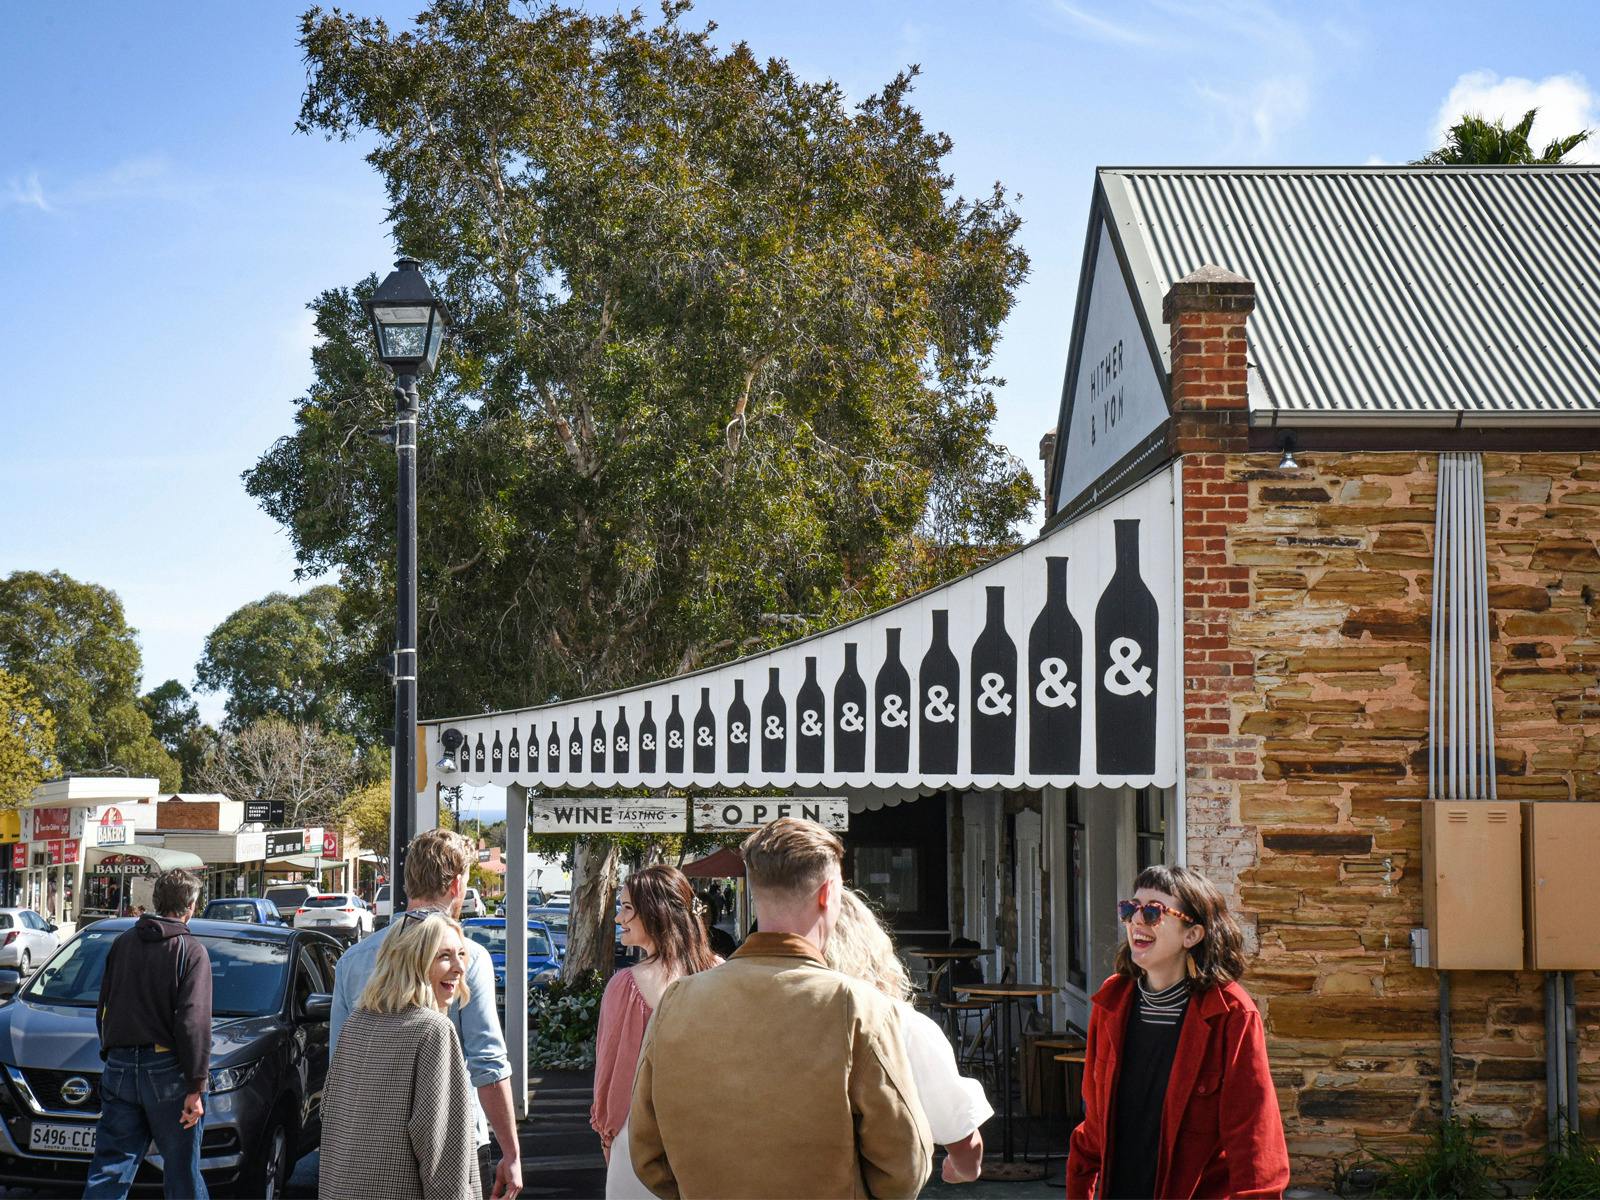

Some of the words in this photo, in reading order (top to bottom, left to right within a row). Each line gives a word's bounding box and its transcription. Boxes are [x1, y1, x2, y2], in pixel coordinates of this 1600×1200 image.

[1091, 339, 1123, 404] HITHER
[1091, 413, 1096, 447] &
[1104, 385, 1124, 434] YON
[461, 750, 470, 761] &
[476, 749, 485, 760] &
[492, 748, 502, 759] &
[509, 746, 519, 759] &
[528, 745, 539, 758] &
[548, 743, 560, 757] &
[570, 741, 582, 756] &
[592, 738, 606, 754] &
[615, 735, 629, 752] &
[643, 734, 655, 750] &
[669, 730, 683, 748] &
[697, 727, 713, 746] &
[730, 722, 747, 743] &
[765, 716, 784, 739] &
[801, 710, 822, 736] &
[840, 702, 864, 731] &
[881, 695, 908, 727] &
[925, 685, 955, 723] &
[978, 673, 1012, 716] &
[1036, 658, 1076, 708] &
[1104, 637, 1153, 696] &
[553, 806, 613, 824] WINE
[618, 810, 665, 820] TASTING
[722, 804, 820, 825] OPEN
[98, 827, 125, 842] BAKERY
[95, 864, 149, 874] BAKERY
